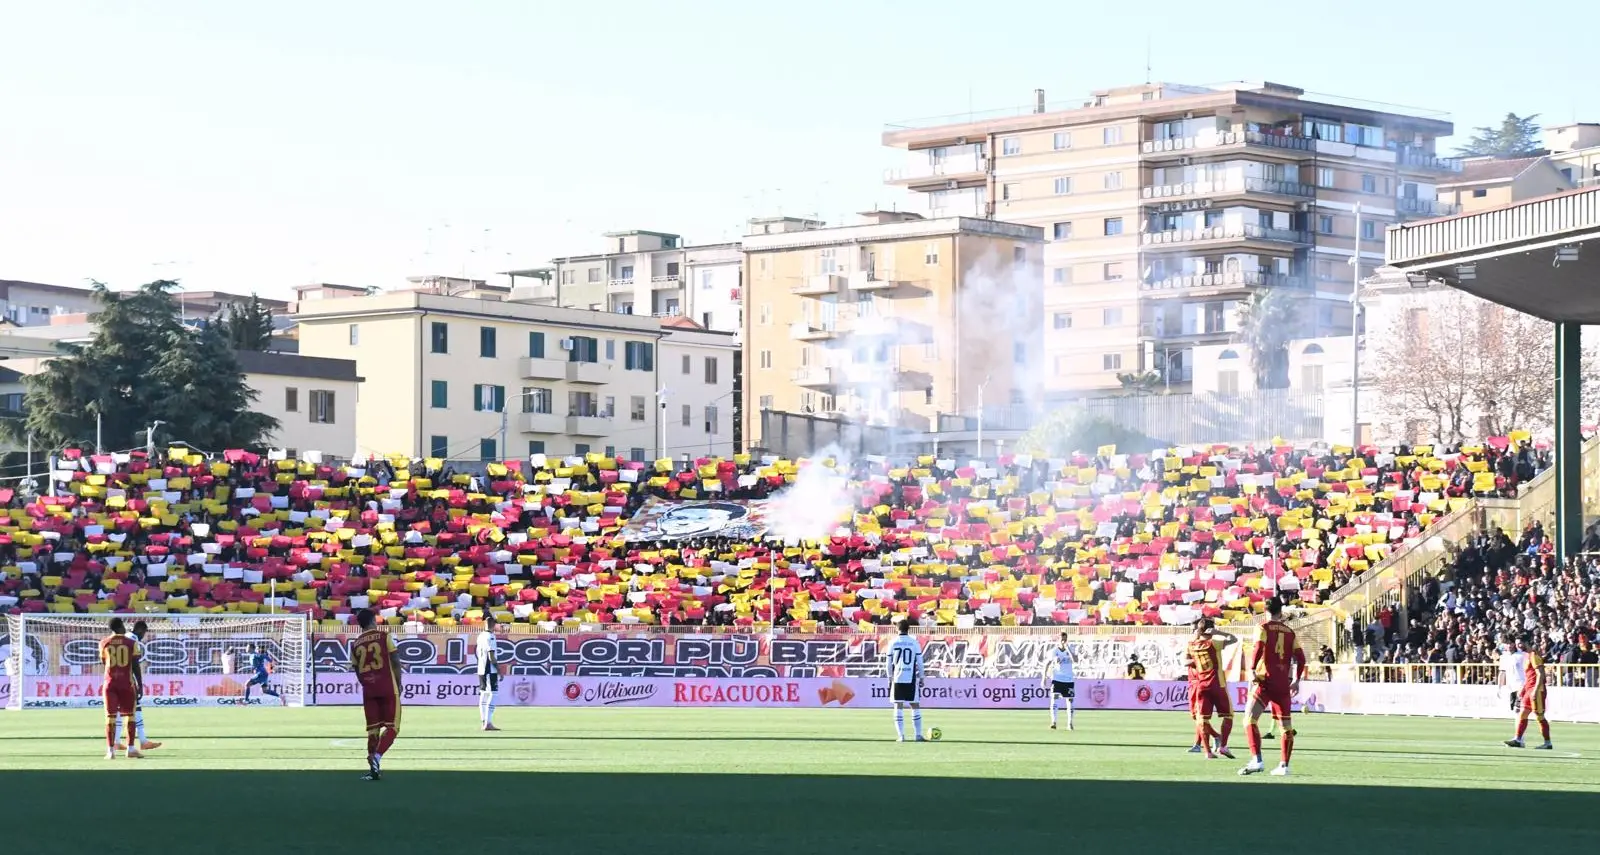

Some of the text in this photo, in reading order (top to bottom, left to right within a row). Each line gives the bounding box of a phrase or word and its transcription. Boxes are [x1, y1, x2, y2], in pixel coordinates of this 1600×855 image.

[355, 642, 384, 673] 23
[676, 634, 759, 665] PIÙ
[894, 647, 913, 665] 70
[400, 680, 431, 699] gni
[585, 681, 655, 702] Molisana
[674, 683, 800, 703] RIGACUORE
[982, 684, 1016, 703] ogni
